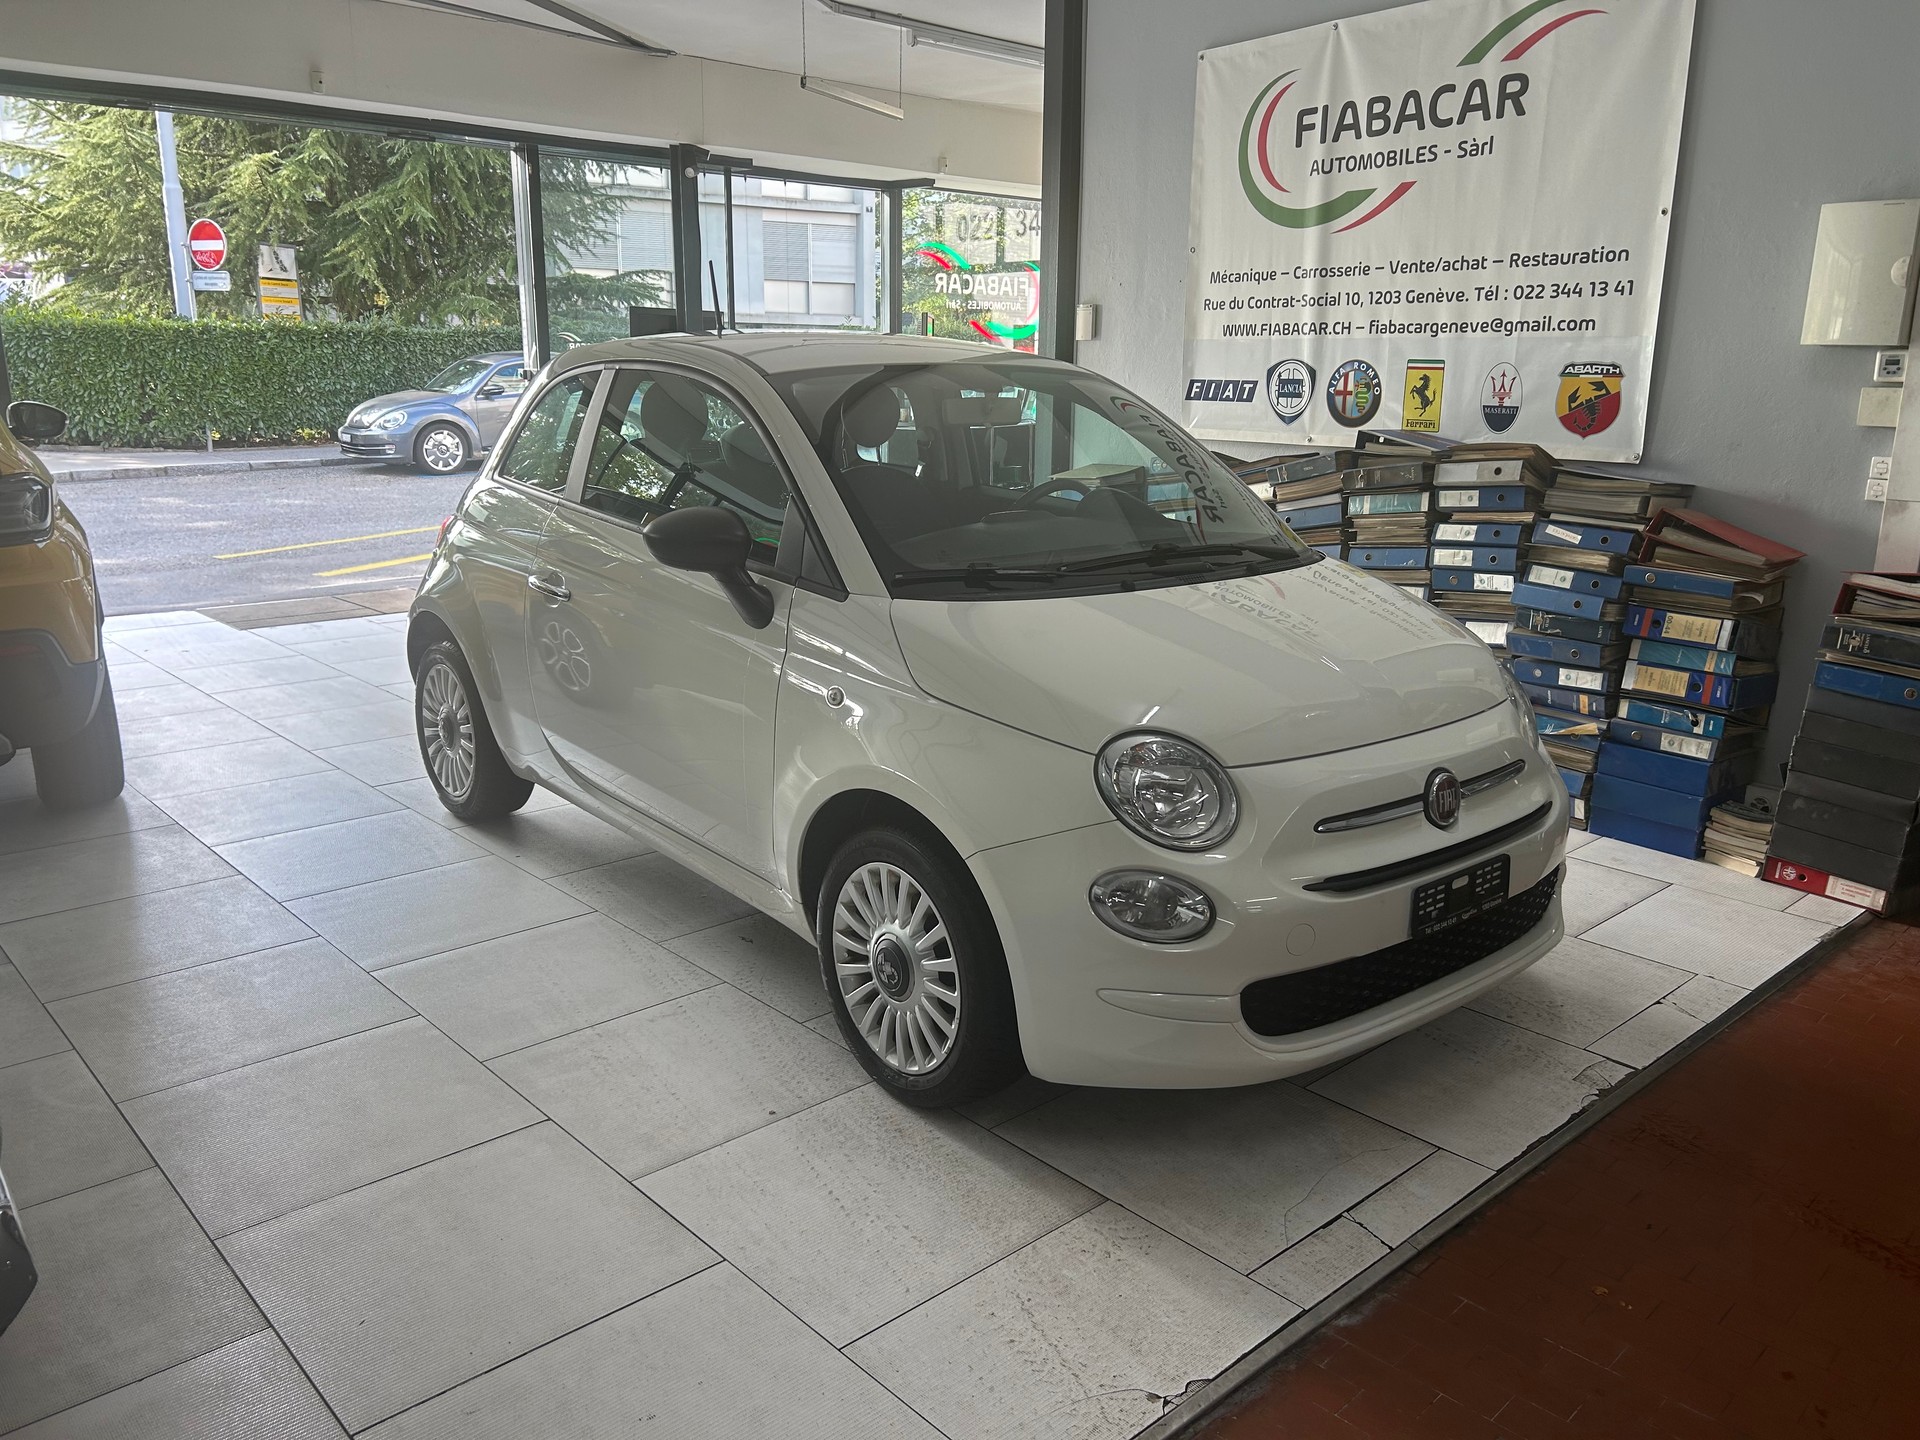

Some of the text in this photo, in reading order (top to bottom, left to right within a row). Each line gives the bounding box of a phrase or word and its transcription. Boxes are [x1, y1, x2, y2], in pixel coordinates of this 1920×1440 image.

[1294, 72, 1530, 149] FIABACAR
[1309, 143, 1439, 177] AUTOMOBILES
[1456, 135, 1495, 159] Sàrl
[957, 212, 994, 242] 022
[1209, 267, 1278, 287] Mécanique
[1293, 262, 1371, 280] Carrosserie
[1389, 254, 1489, 275] Vente/achat
[1508, 245, 1630, 269] Restauration
[1203, 298, 1226, 312] Rue
[1228, 295, 1245, 311] du
[1247, 290, 1342, 310] Contrat-Social
[1344, 291, 1364, 309] 10,
[1368, 289, 1402, 306] 1203
[1405, 286, 1470, 305] Genève.
[1473, 284, 1500, 302] Tél
[1513, 283, 1546, 301] 022
[1549, 282, 1583, 300] 344
[1589, 280, 1609, 298] 13
[1613, 279, 1634, 297] 41
[1222, 321, 1352, 338] WWW.FIABACAR.CH
[1368, 315, 1596, 338] fiabacargeneve@gmail.com
[1328, 361, 1382, 395] ALFA ROMEO
[1563, 365, 1621, 374] ABARTH
[1190, 382, 1254, 399] FIAT
[1279, 382, 1303, 394] LANCIA
[1405, 419, 1436, 429] Ferrari
[1483, 407, 1518, 415] MASERATI
[1438, 787, 1457, 813] FIAT
